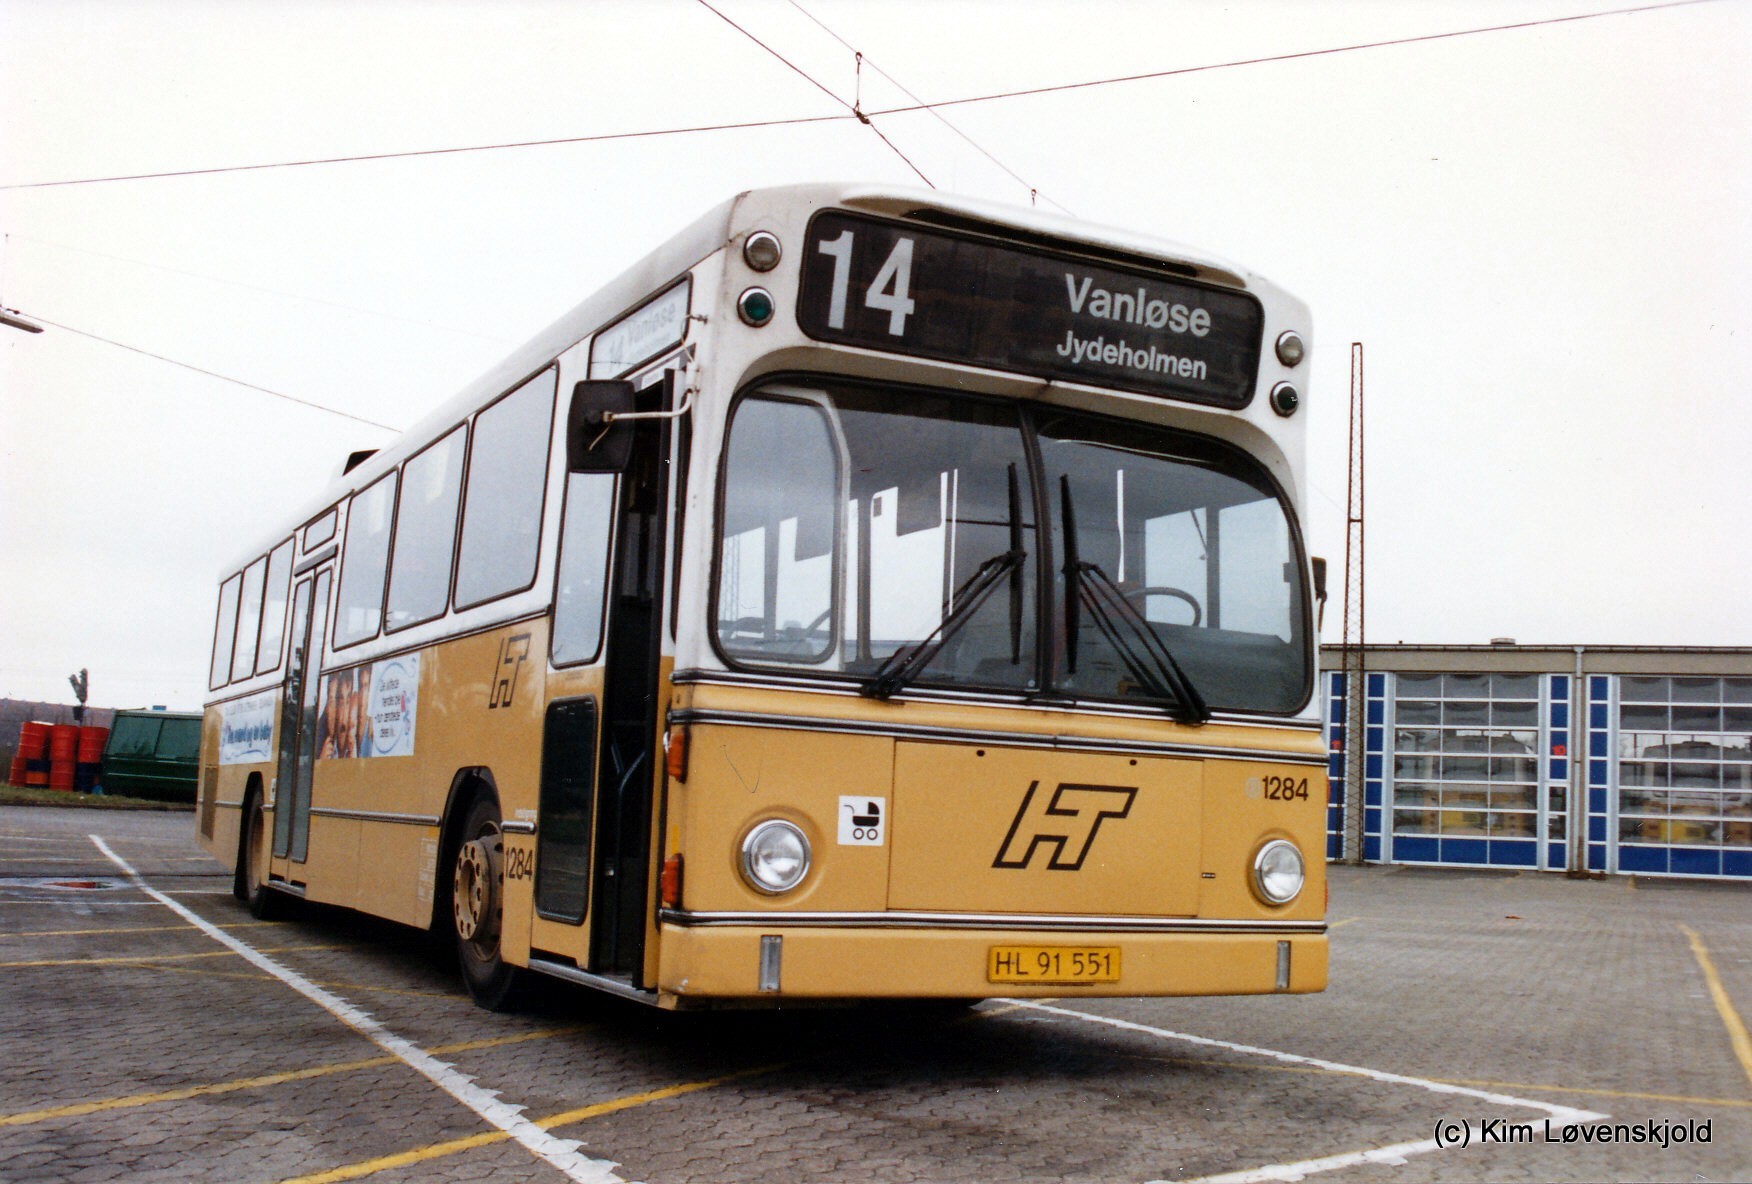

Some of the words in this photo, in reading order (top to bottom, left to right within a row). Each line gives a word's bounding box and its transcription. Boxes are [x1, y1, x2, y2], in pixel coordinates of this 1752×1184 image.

[818, 229, 915, 337] 14
[1065, 273, 1211, 337] Vanløse
[1056, 330, 1207, 381] Jydeholmen
[1262, 775, 1309, 801] 1284
[505, 847, 533, 881] 1284
[995, 952, 1029, 975] HL
[1037, 952, 1060, 976] 91
[1073, 952, 1112, 976] 551
